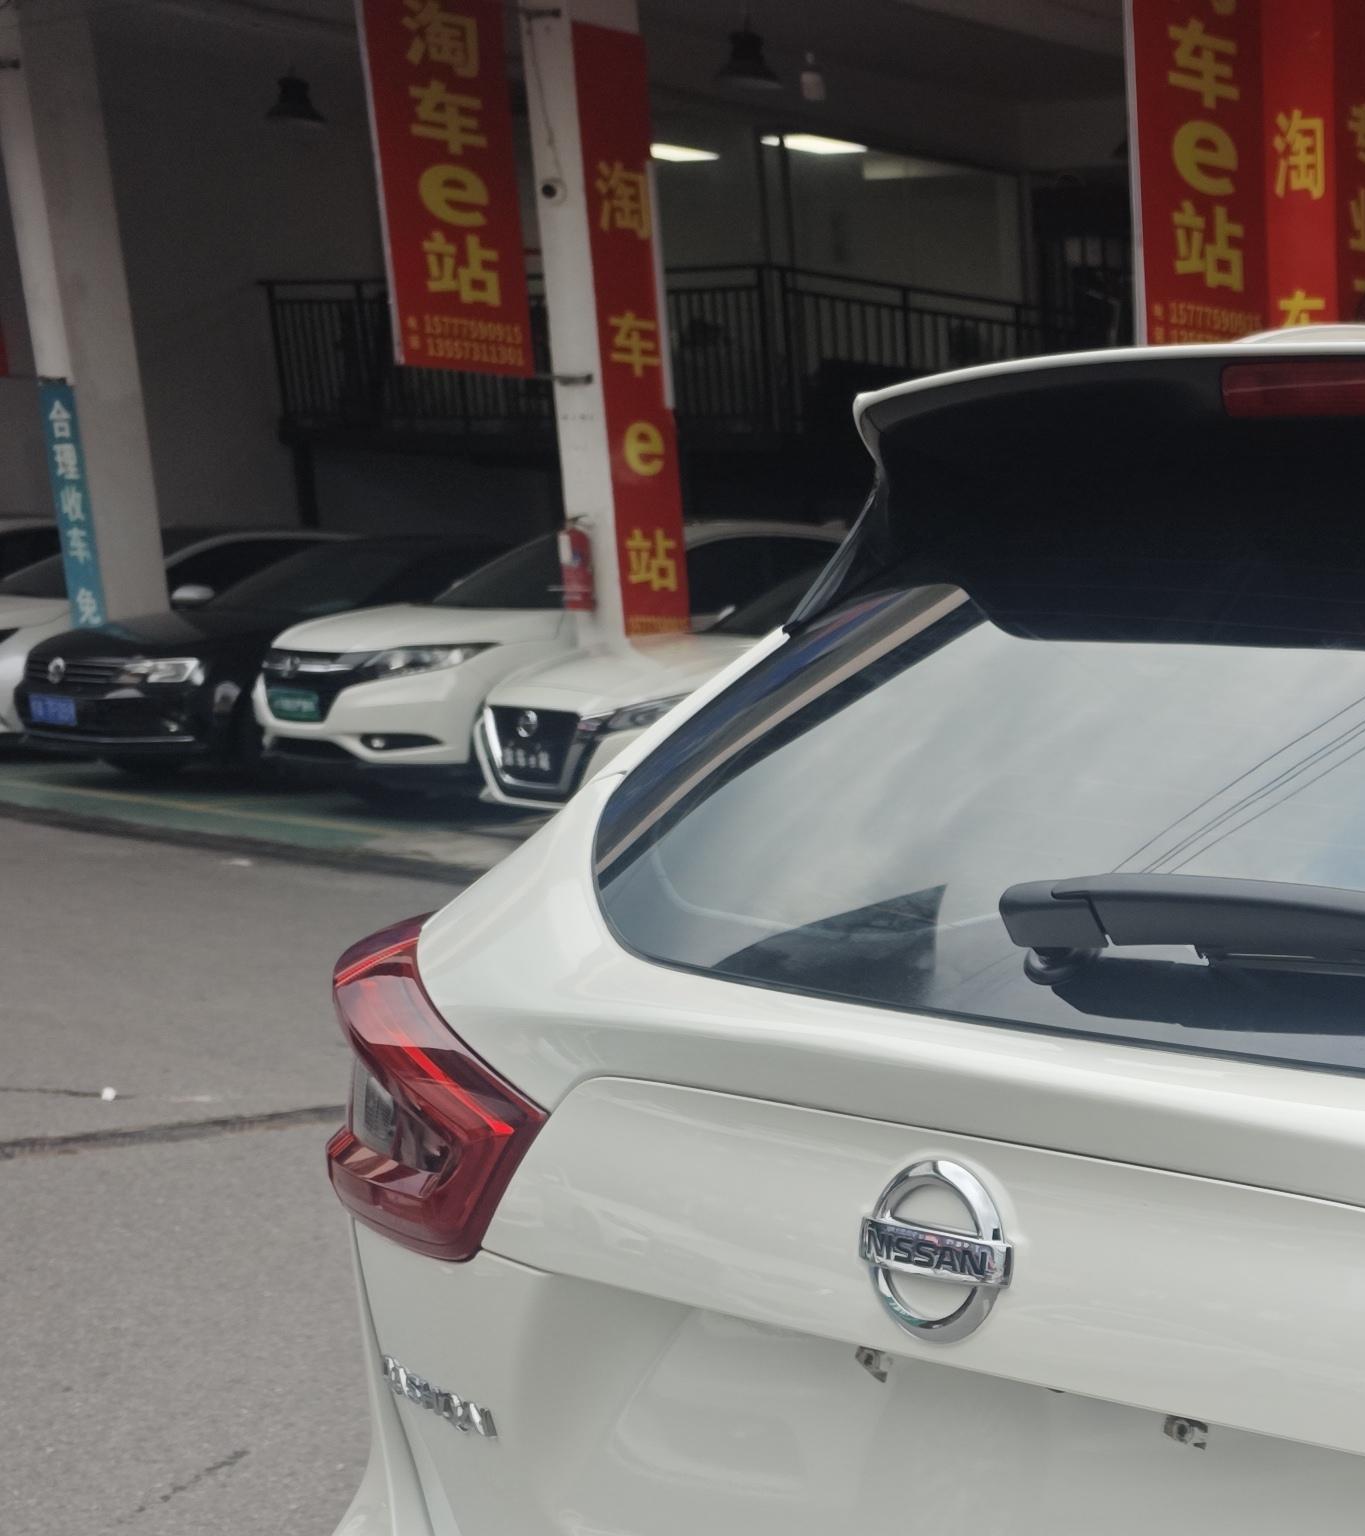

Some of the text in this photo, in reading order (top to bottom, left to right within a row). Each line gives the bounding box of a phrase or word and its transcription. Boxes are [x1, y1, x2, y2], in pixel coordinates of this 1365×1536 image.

[401, 0, 503, 308] 淘车e站
[1168, 0, 1245, 293] 车e站
[49, 399, 92, 565] 合理收车
[597, 161, 678, 592] 淘车e站
[866, 1224, 992, 1280] NISSAN
